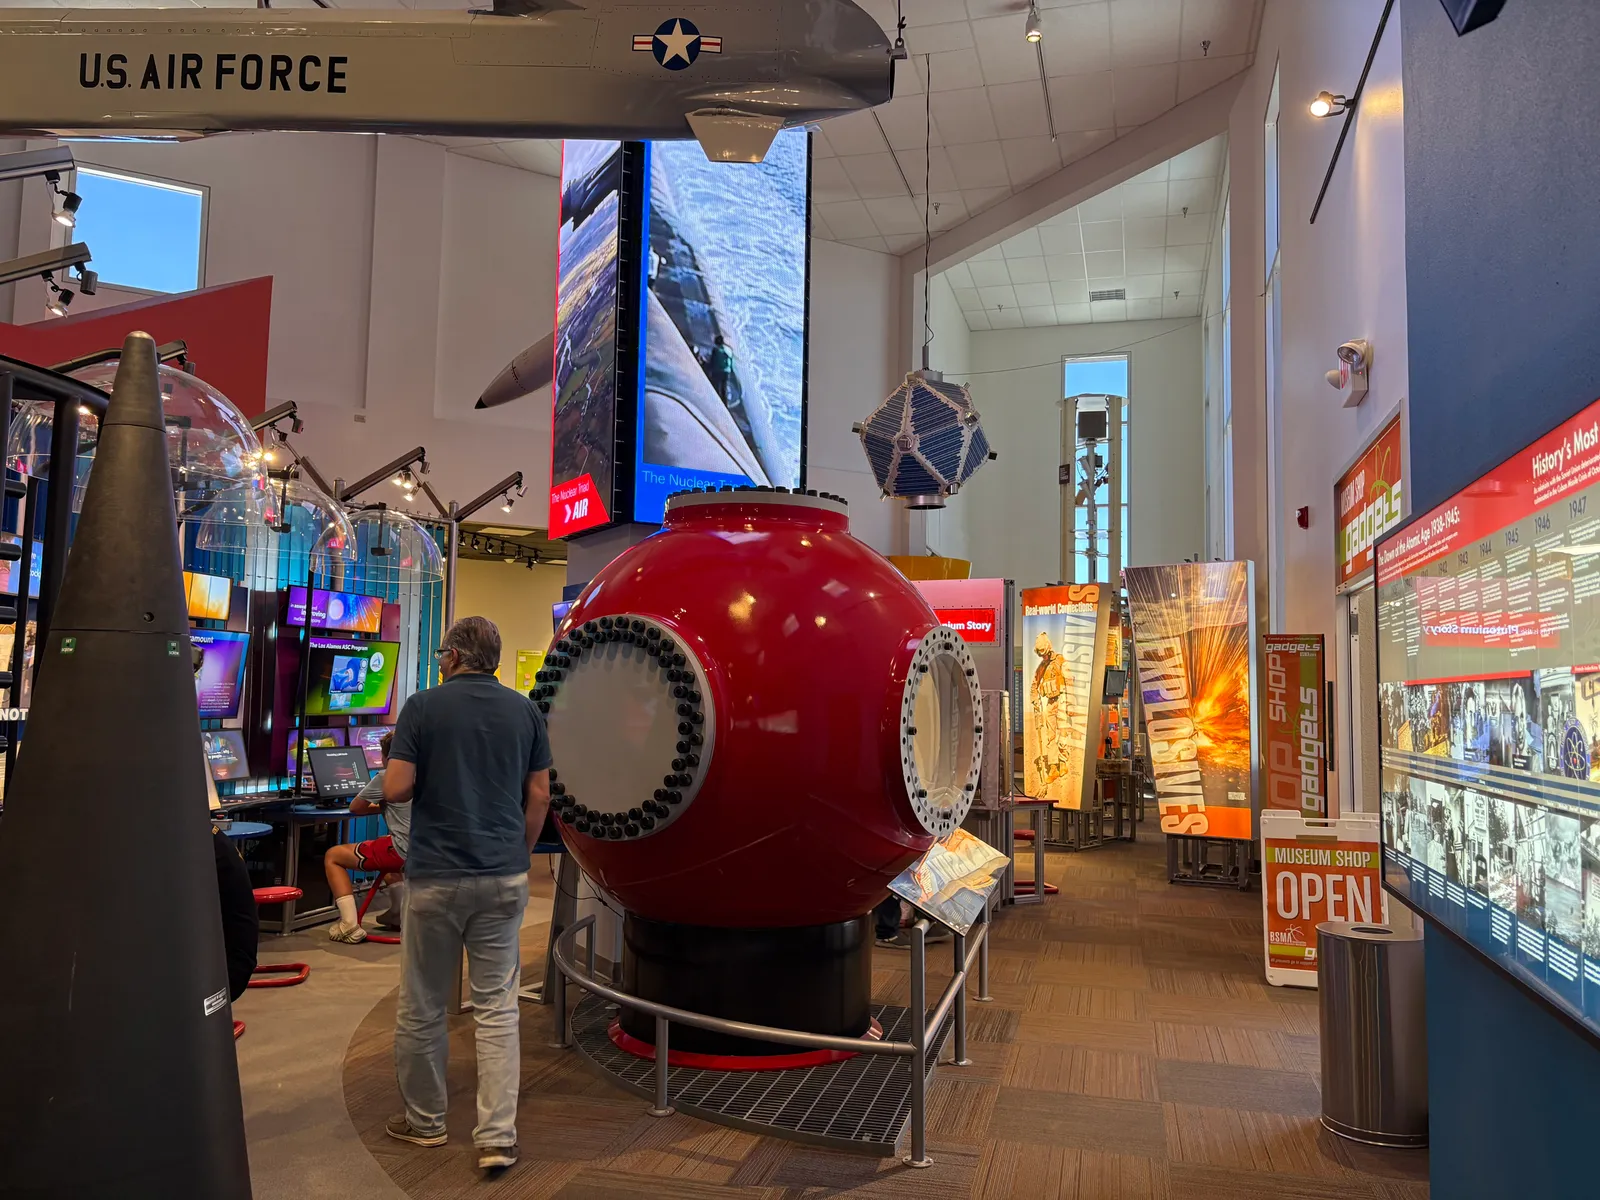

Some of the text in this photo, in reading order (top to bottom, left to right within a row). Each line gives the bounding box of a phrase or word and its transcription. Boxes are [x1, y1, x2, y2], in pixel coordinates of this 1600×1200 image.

[79, 52, 348, 93] U.S. AIR FORCE
[1532, 421, 1599, 479] History's Most
[642, 470, 665, 484] The
[669, 473, 716, 488] Nuclear
[552, 480, 590, 504] The Nuclear Triad
[572, 498, 588, 520] AIR
[1569, 496, 1587, 518] 1947
[1345, 479, 1401, 575] gadgets
[1534, 513, 1551, 534] 1946
[1384, 549, 1395, 563] Dawn
[1406, 530, 1420, 551] Atomic
[1421, 527, 1431, 545] Age
[1505, 528, 1519, 546] 1945
[1457, 551, 1469, 565] 1943
[1479, 540, 1492, 557] 1944
[1025, 602, 1093, 617] Real-world Connections
[966, 620, 991, 632] Story
[1266, 642, 1321, 654] gadgets
[1268, 654, 1287, 723] SHOP
[0, 708, 28, 721] NOT
[1135, 636, 1209, 835] EXPLOSIVES
[1298, 686, 1325, 813] gadgets
[1274, 847, 1331, 867] MUSEUM
[1335, 850, 1371, 868] SHOP
[1276, 871, 1372, 924] OPEN
[1270, 931, 1293, 943] BSMA
